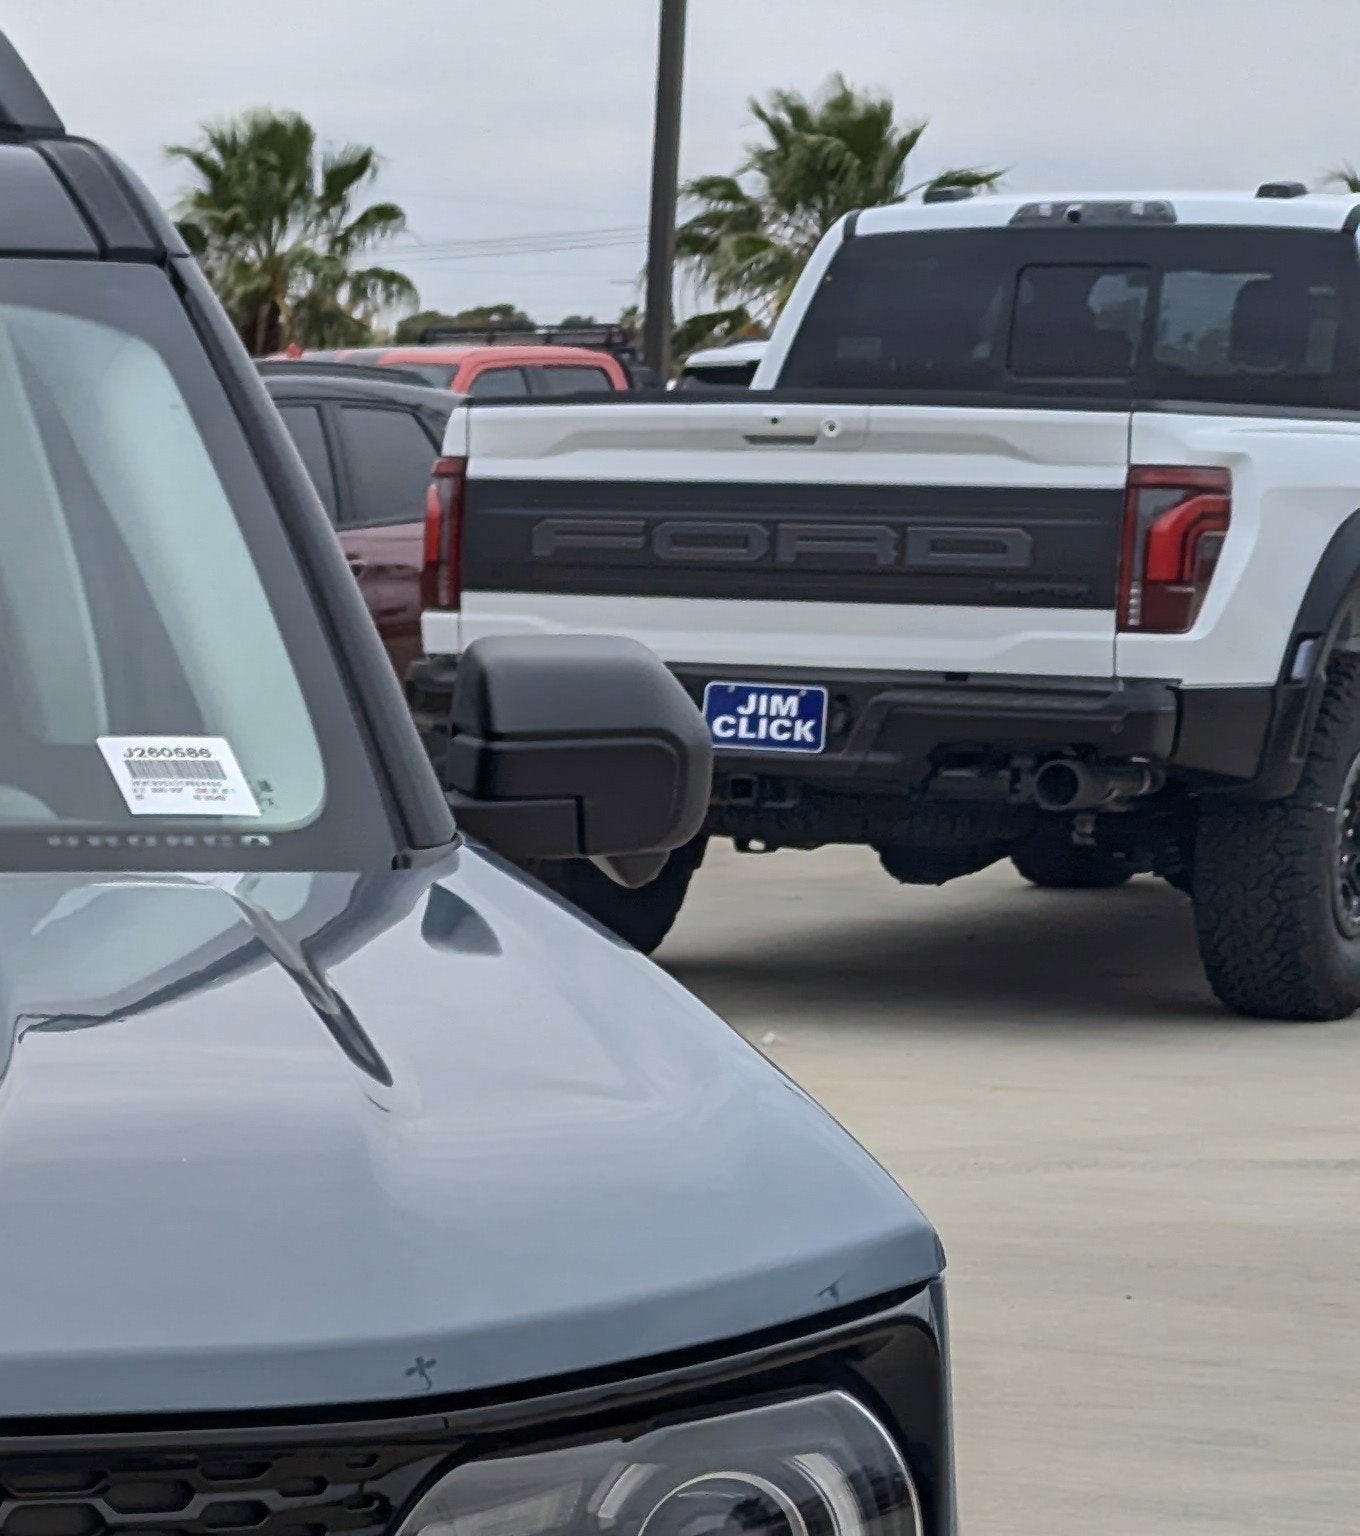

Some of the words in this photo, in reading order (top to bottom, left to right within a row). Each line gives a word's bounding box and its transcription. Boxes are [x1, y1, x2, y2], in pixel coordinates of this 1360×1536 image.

[532, 518, 1033, 567] FORD
[736, 692, 800, 718] JIM
[711, 714, 817, 743] CLICK
